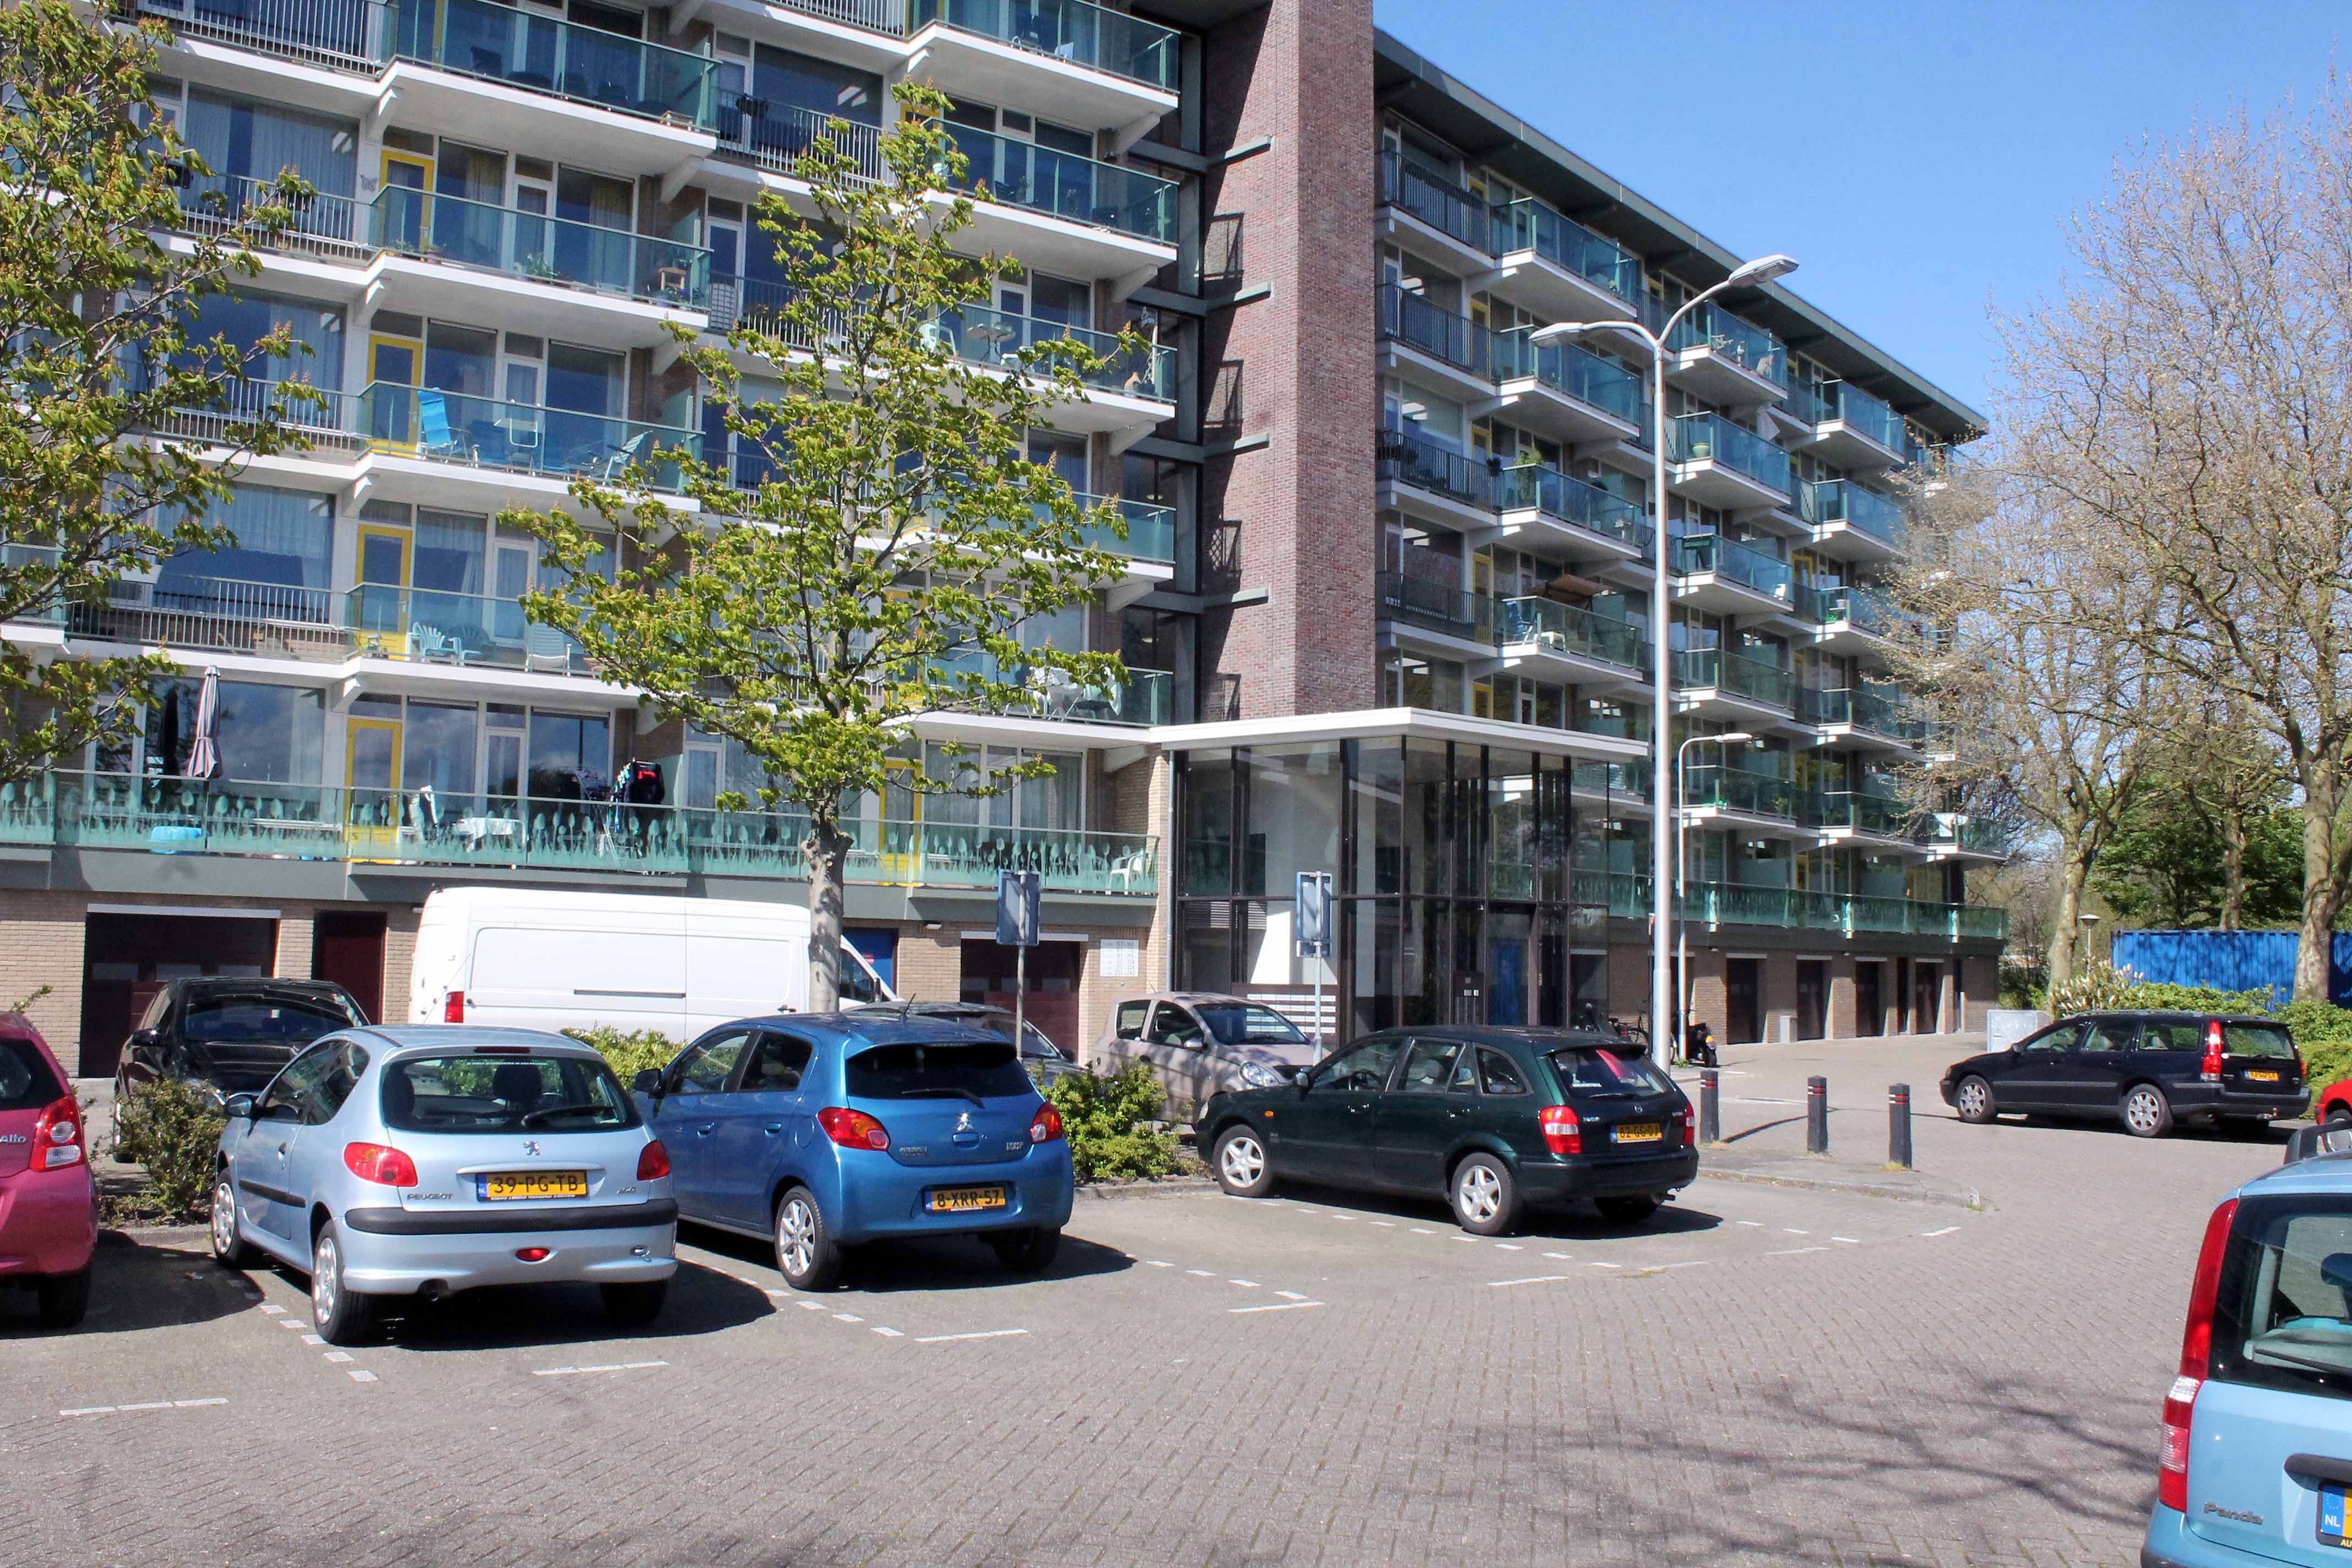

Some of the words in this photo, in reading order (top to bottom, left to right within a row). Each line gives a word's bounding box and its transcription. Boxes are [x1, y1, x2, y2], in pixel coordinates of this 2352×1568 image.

[0, 1134, 26, 1144] Alto
[493, 1175, 578, 1193] 39-PG-TB
[937, 1189, 1000, 1207] 8-XRR-57
[2203, 1501, 2264, 1525] Panda
[2324, 1514, 2340, 1527] NL
